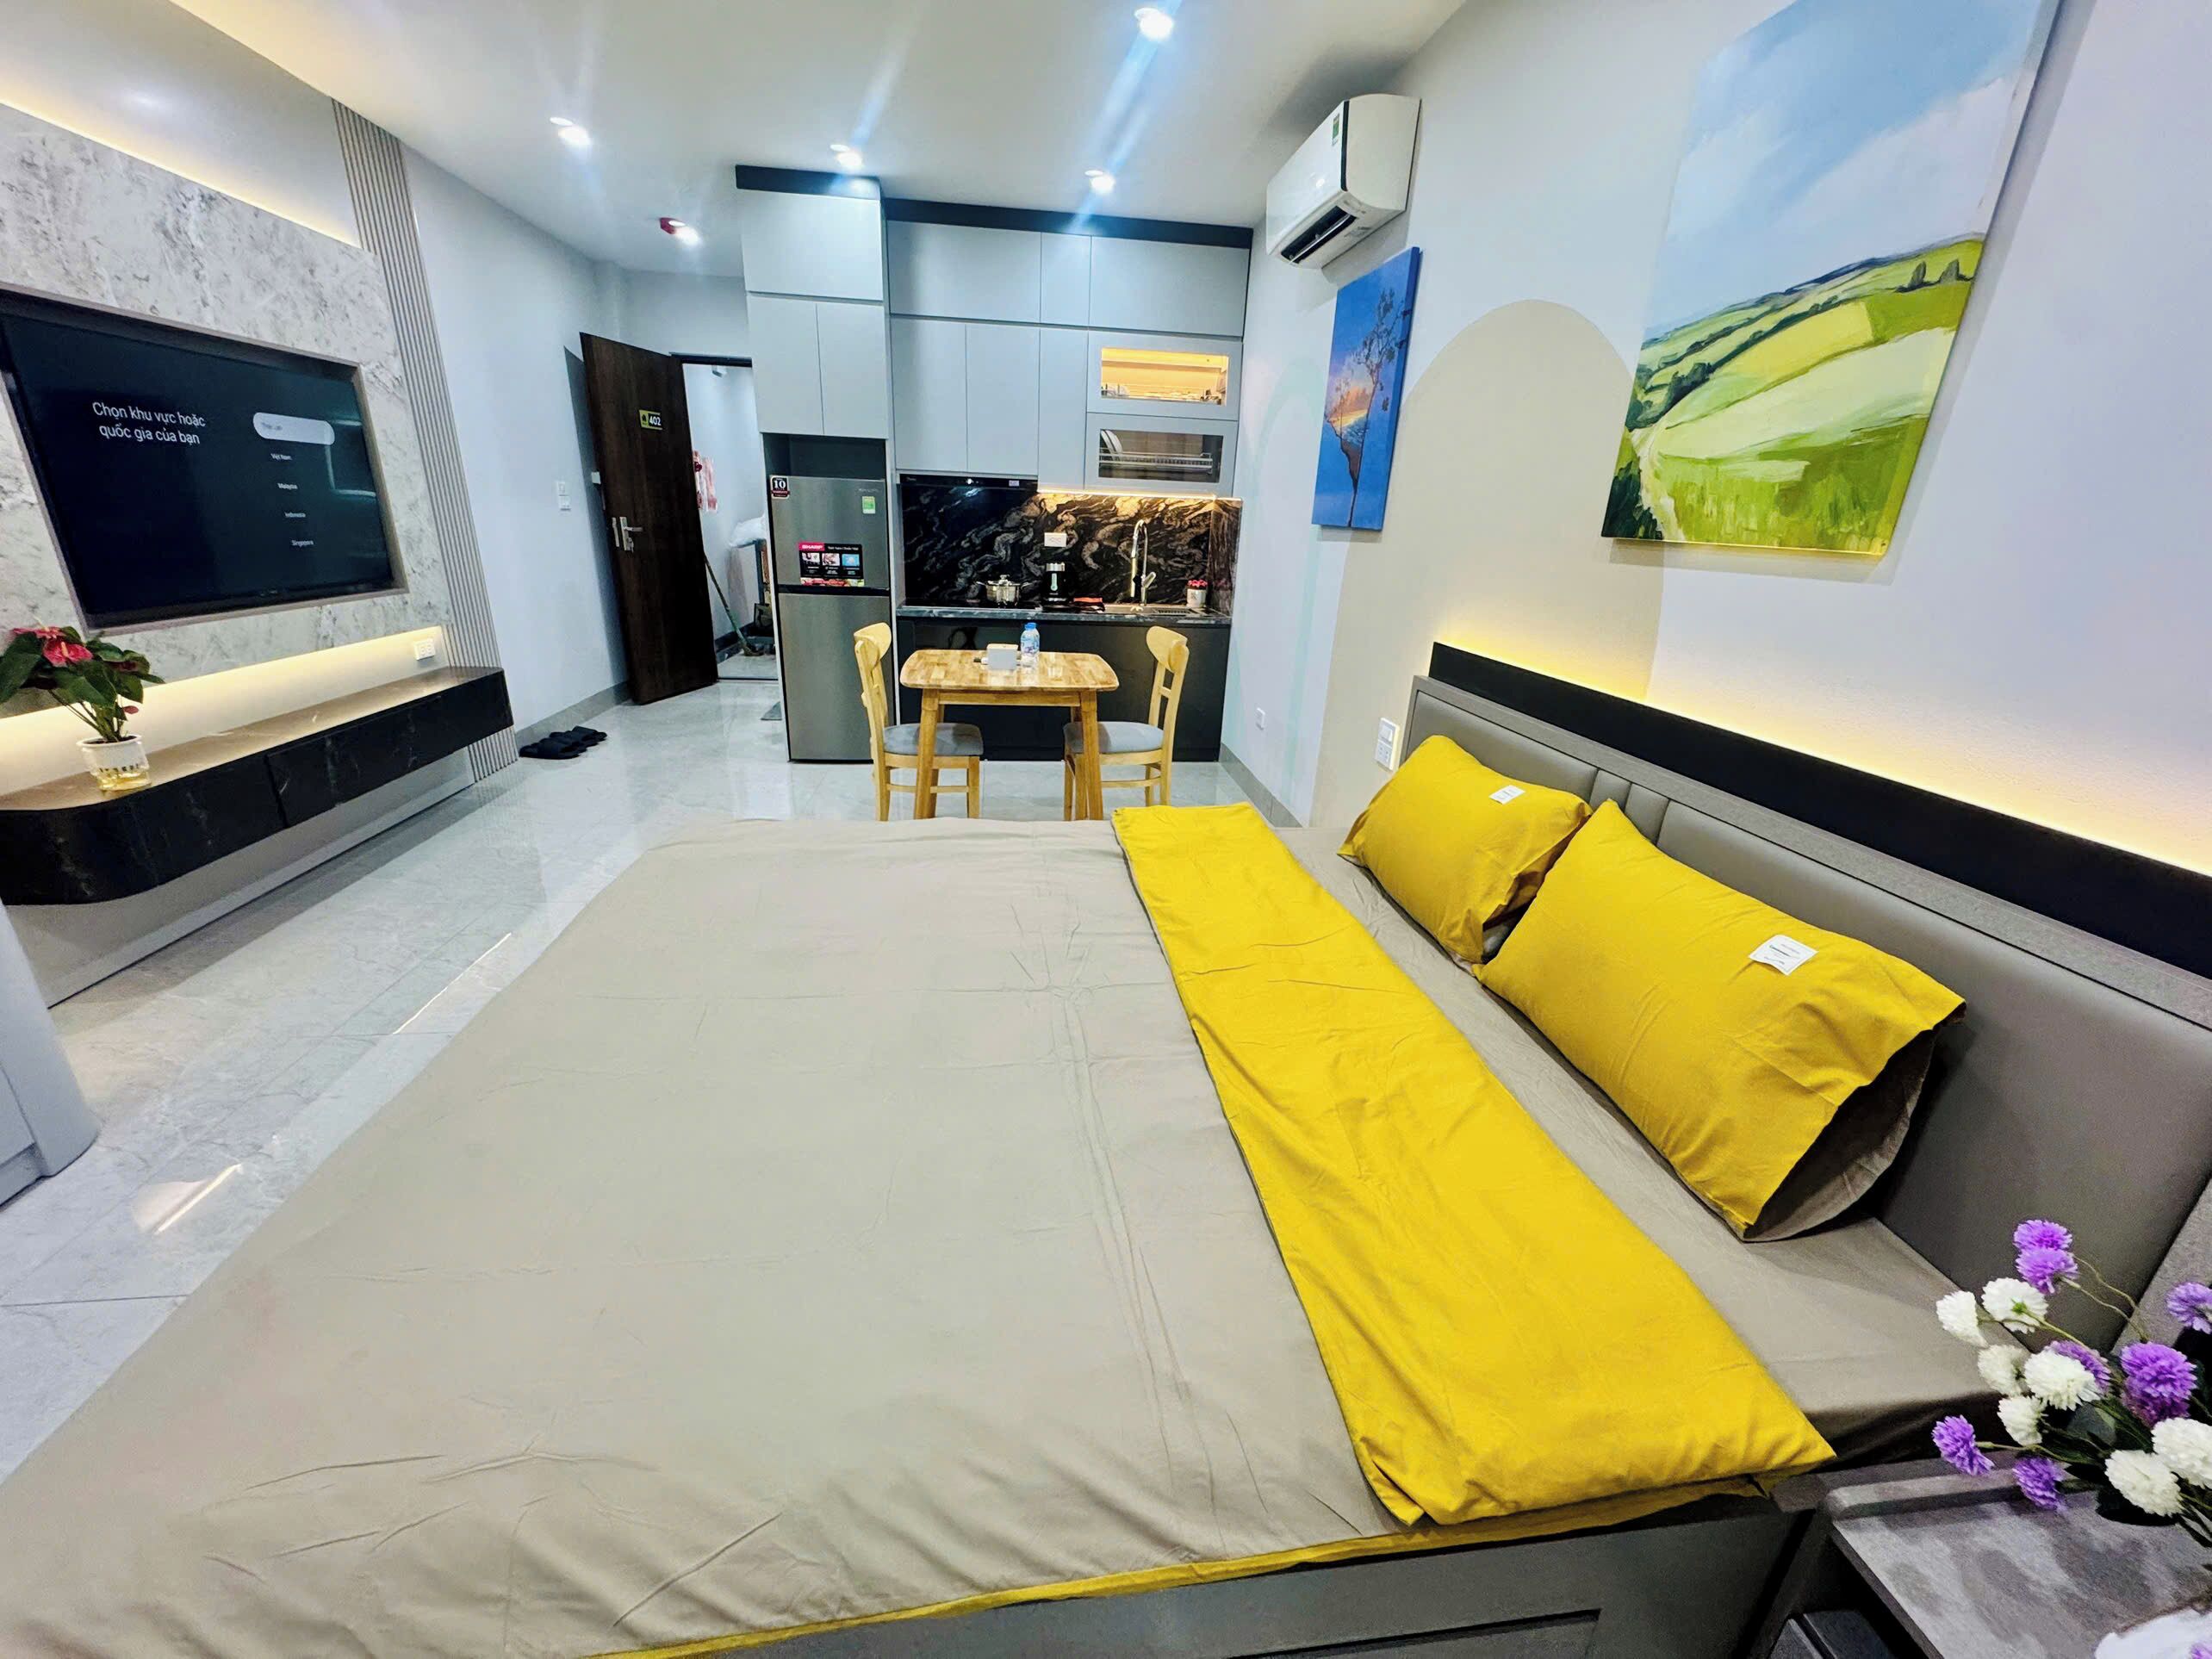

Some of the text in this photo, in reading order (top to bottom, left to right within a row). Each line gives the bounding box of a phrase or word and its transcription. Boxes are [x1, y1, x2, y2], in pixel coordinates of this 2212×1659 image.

[92, 401, 206, 427] Chọn khu vực hoặc
[649, 416, 662, 426] 402
[99, 422, 200, 445] quốc gia của bạn
[774, 480, 786, 488] 10
